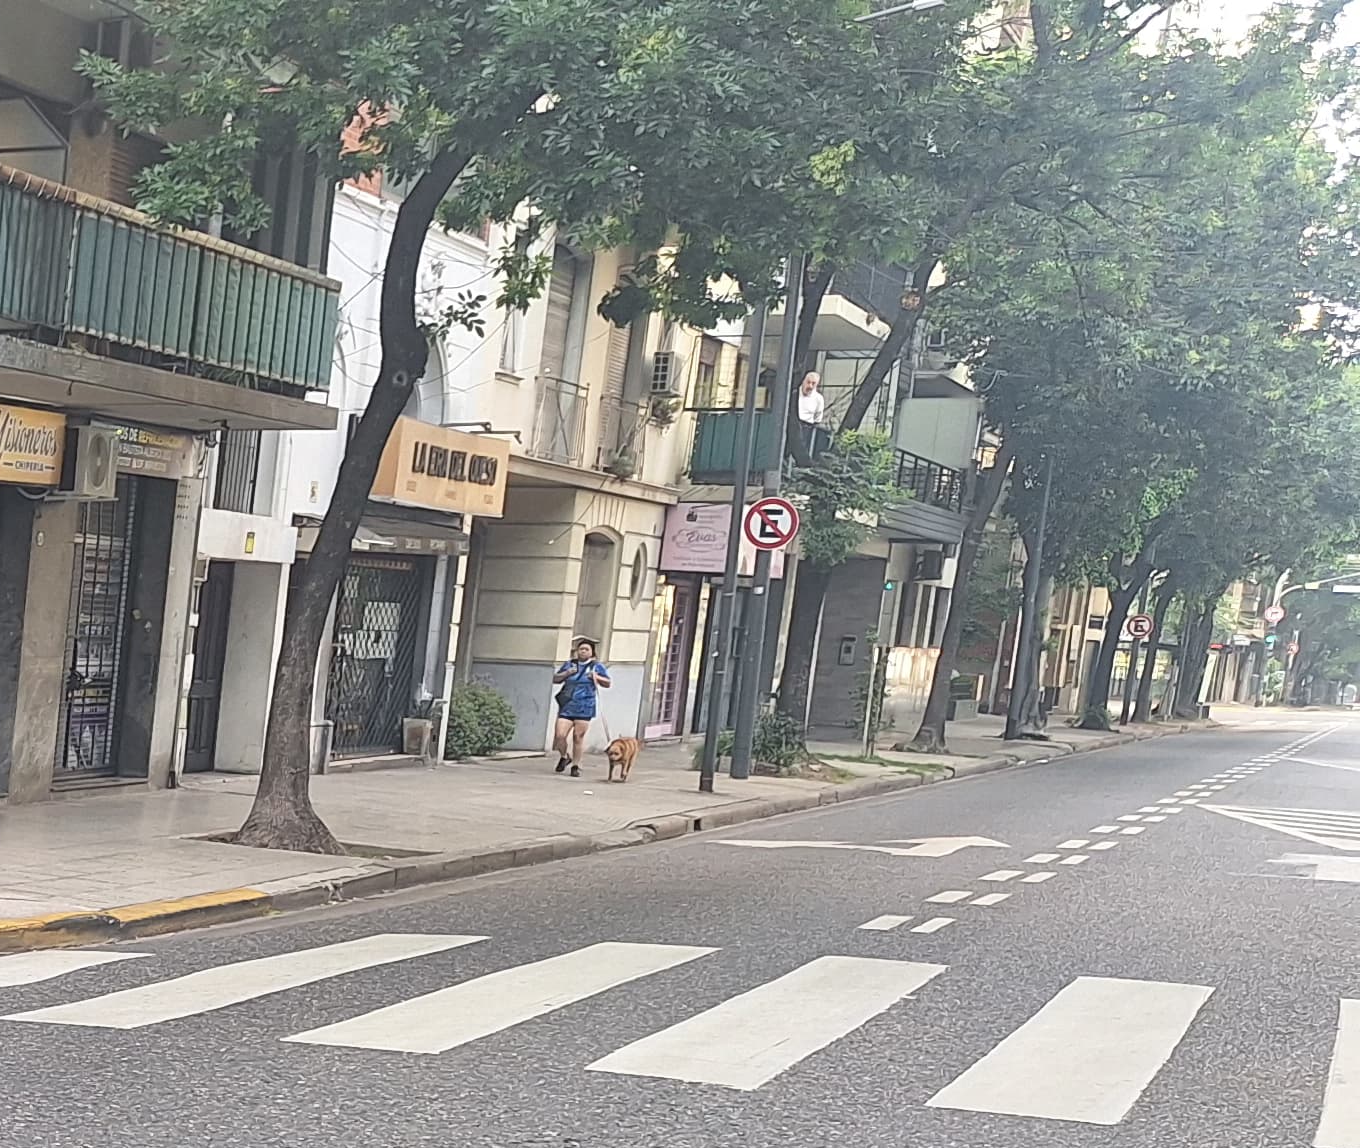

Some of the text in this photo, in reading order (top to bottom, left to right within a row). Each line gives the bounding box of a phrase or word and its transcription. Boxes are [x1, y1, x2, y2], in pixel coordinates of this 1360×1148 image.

[412, 441, 427, 473] LA
[448, 450, 467, 482] DEL
[760, 509, 783, 538] E
